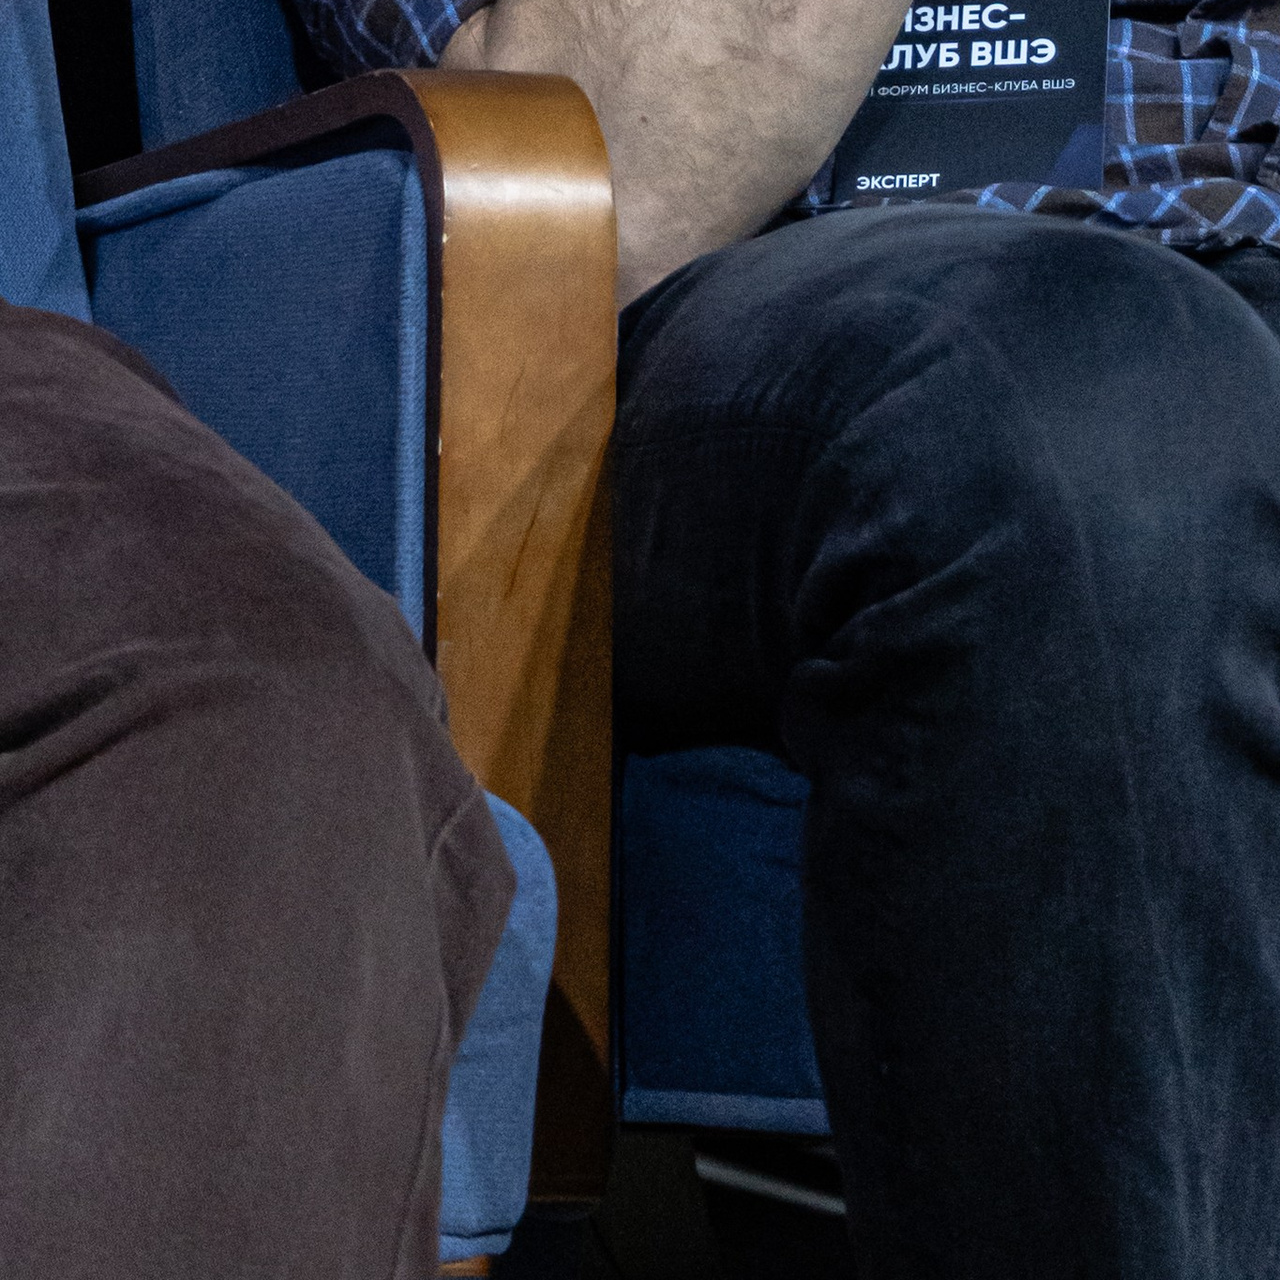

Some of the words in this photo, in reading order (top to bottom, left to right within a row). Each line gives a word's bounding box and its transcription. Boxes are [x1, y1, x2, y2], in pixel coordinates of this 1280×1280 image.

[904, 3, 1026, 33] ЗНЕС-
[879, 42, 960, 71] ЛУБ
[970, 38, 1056, 67] ВШЭ
[877, 84, 929, 96] ФОРУМ
[932, 80, 1038, 95] БИЗНЕС-КЛУБА
[1042, 78, 1076, 90] ВШЭ
[856, 173, 940, 190] ЭКСПЕРТ
